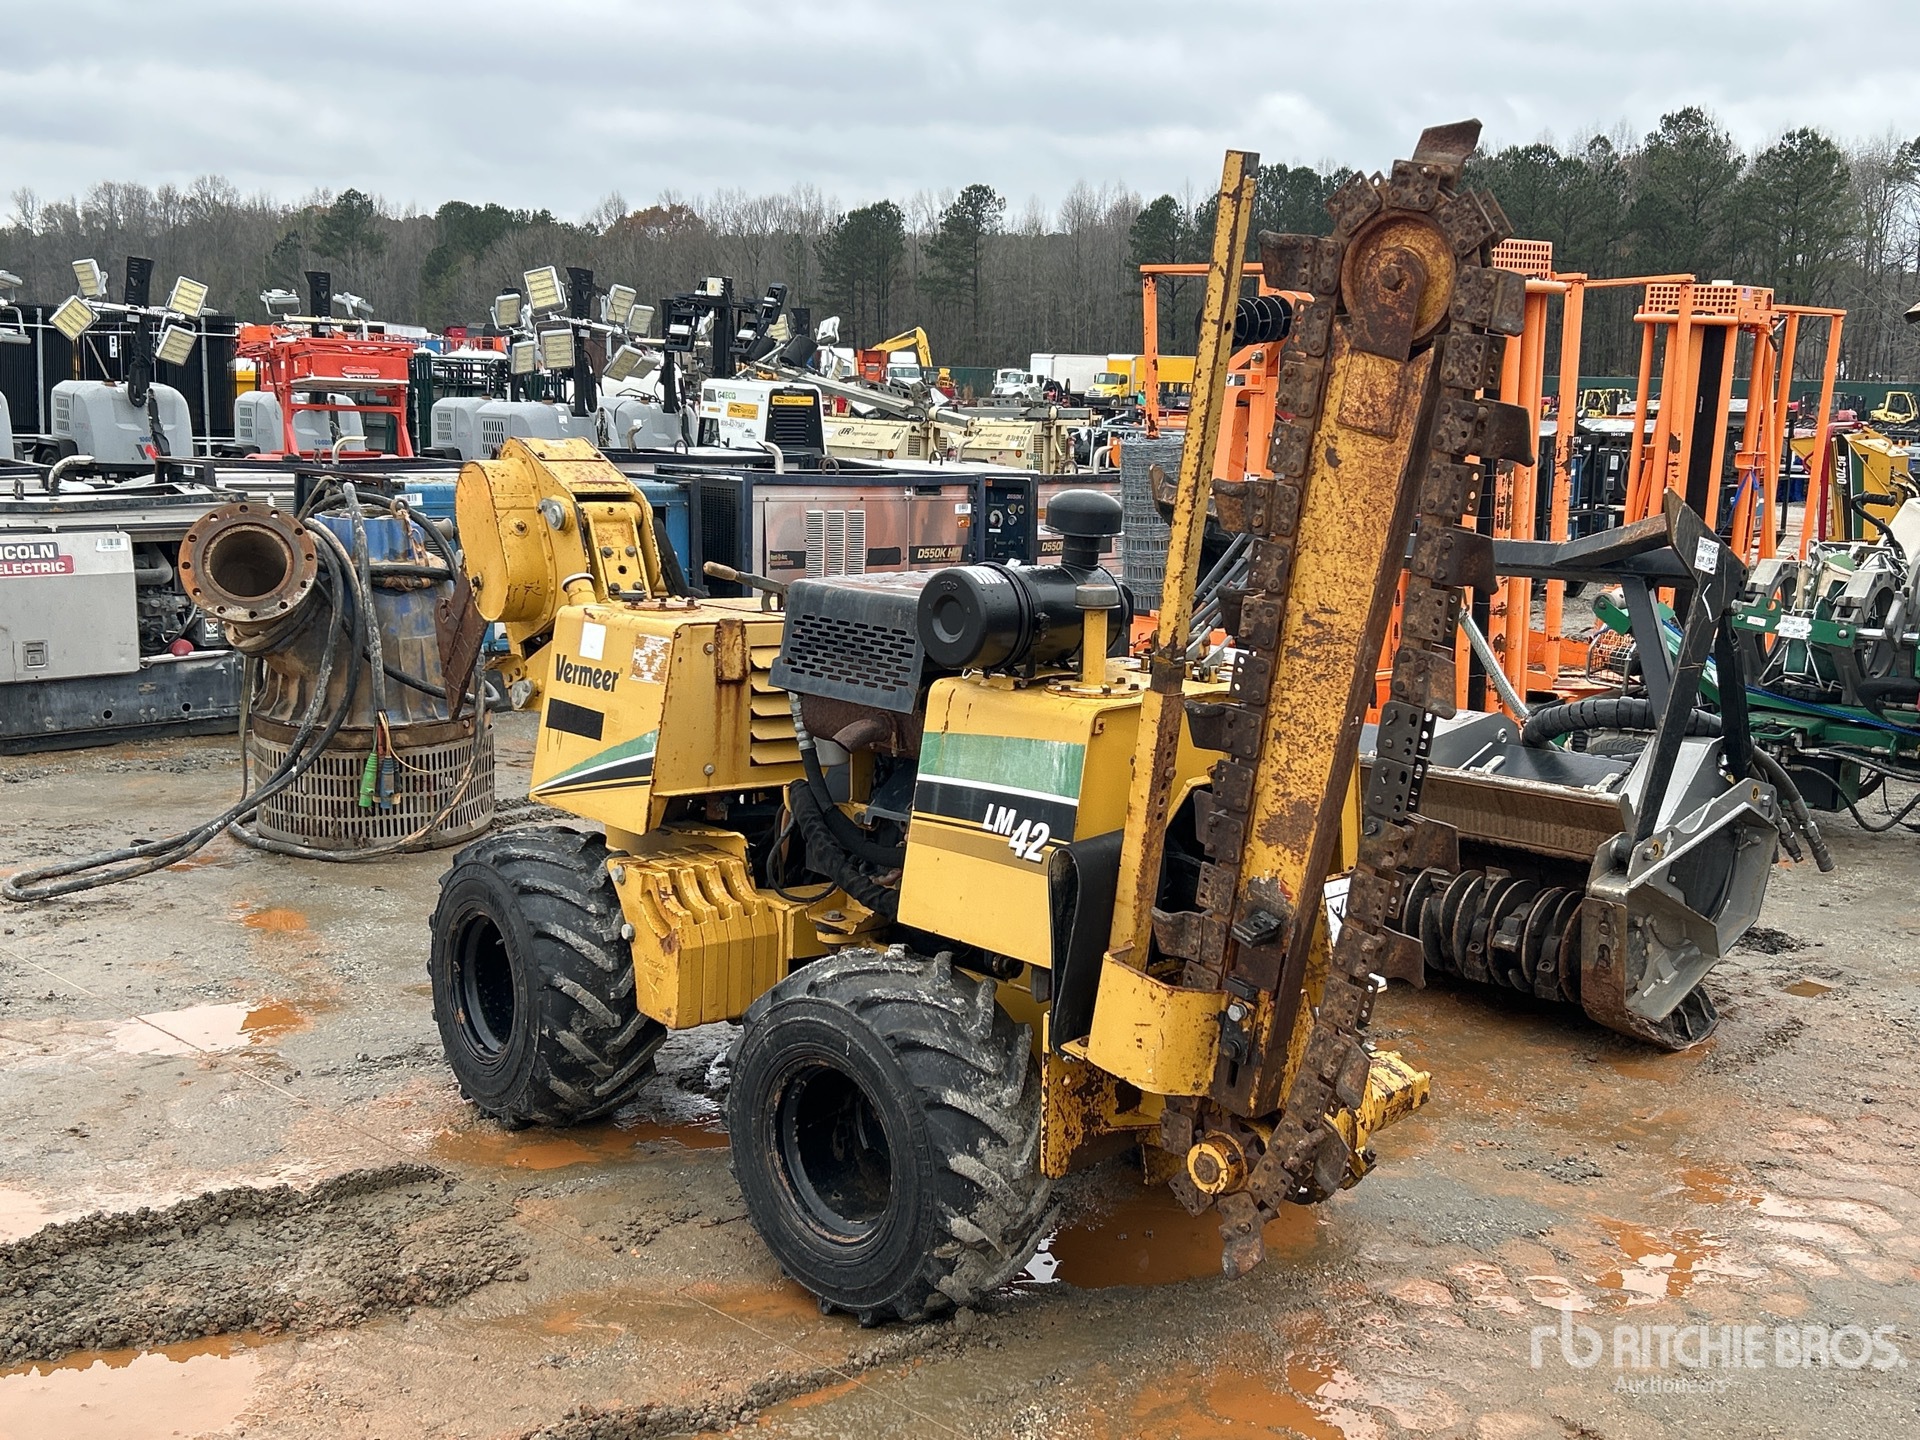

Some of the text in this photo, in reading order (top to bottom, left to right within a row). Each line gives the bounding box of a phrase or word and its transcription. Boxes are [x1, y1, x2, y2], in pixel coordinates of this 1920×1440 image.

[1836, 455, 1847, 485] BC700
[917, 548, 946, 559] D550K
[940, 580, 959, 591] TOP
[556, 653, 620, 692] Vermeer
[982, 803, 1018, 836] LM
[1008, 819, 1051, 862] 42
